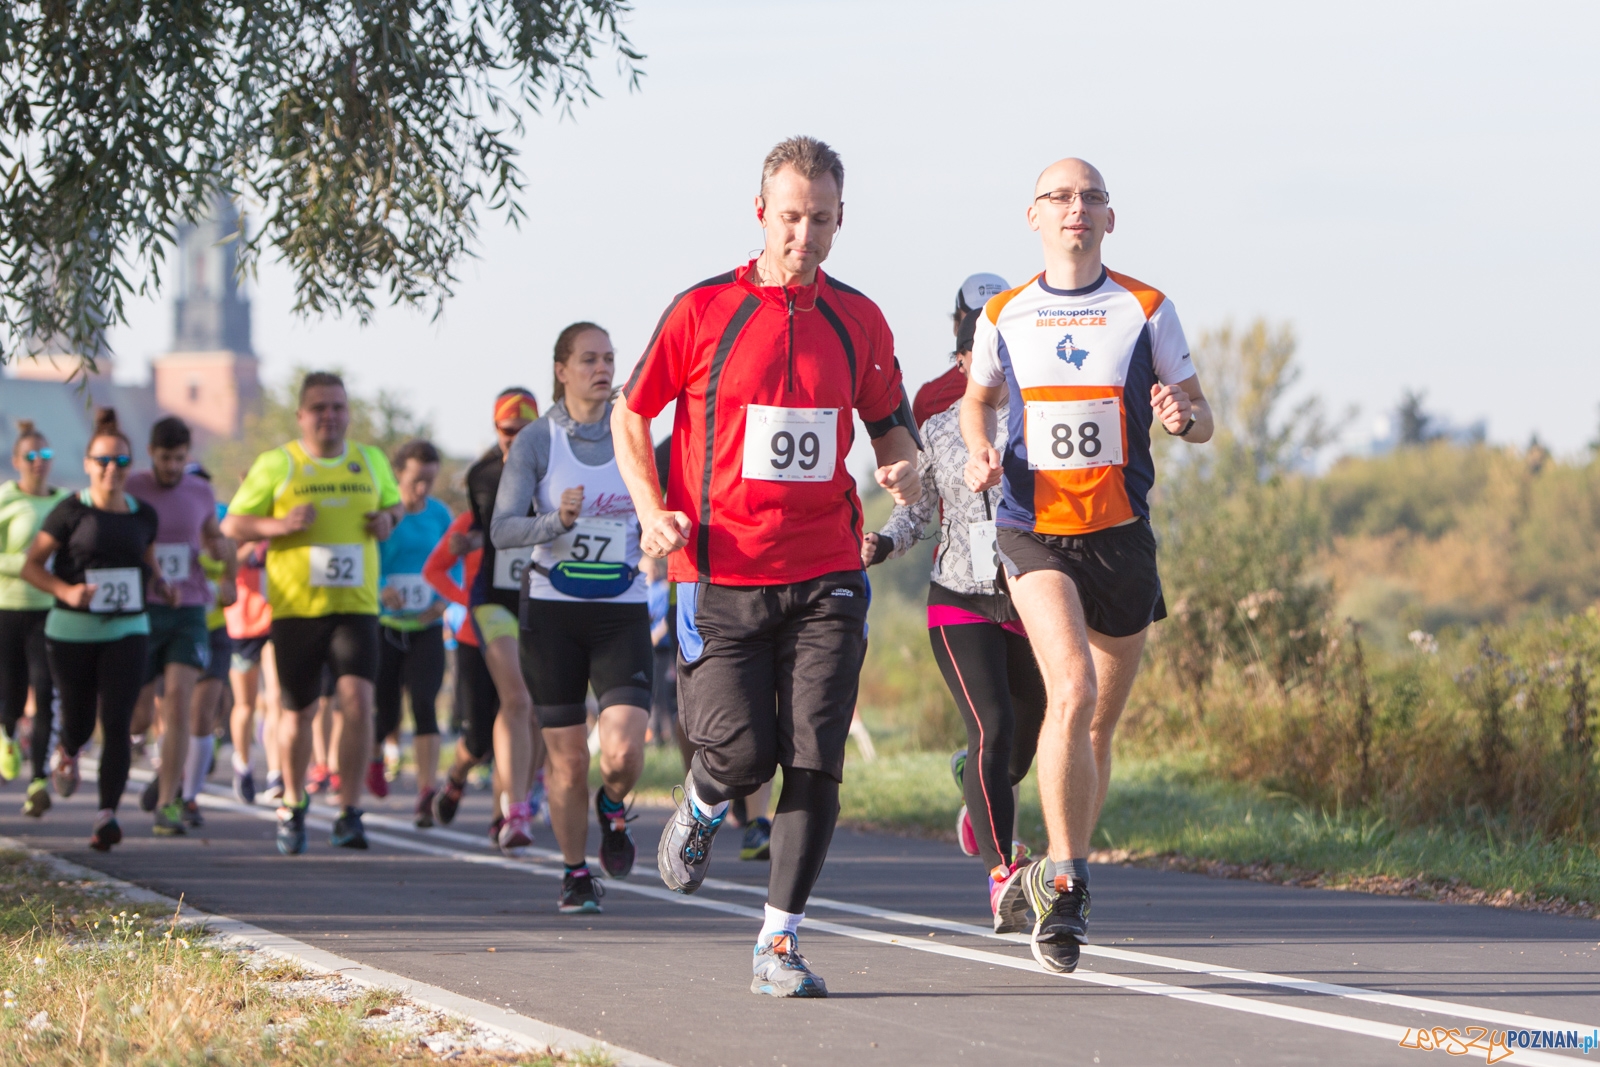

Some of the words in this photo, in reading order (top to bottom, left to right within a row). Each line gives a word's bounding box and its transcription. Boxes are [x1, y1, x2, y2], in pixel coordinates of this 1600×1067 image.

[1036, 317, 1107, 327] BIEGACZE
[1037, 308, 1107, 317] Wielkopolscy
[770, 430, 820, 471] 99
[1051, 421, 1102, 459] 88
[571, 533, 612, 562] 57
[325, 557, 354, 580] 52
[102, 581, 130, 603] 28
